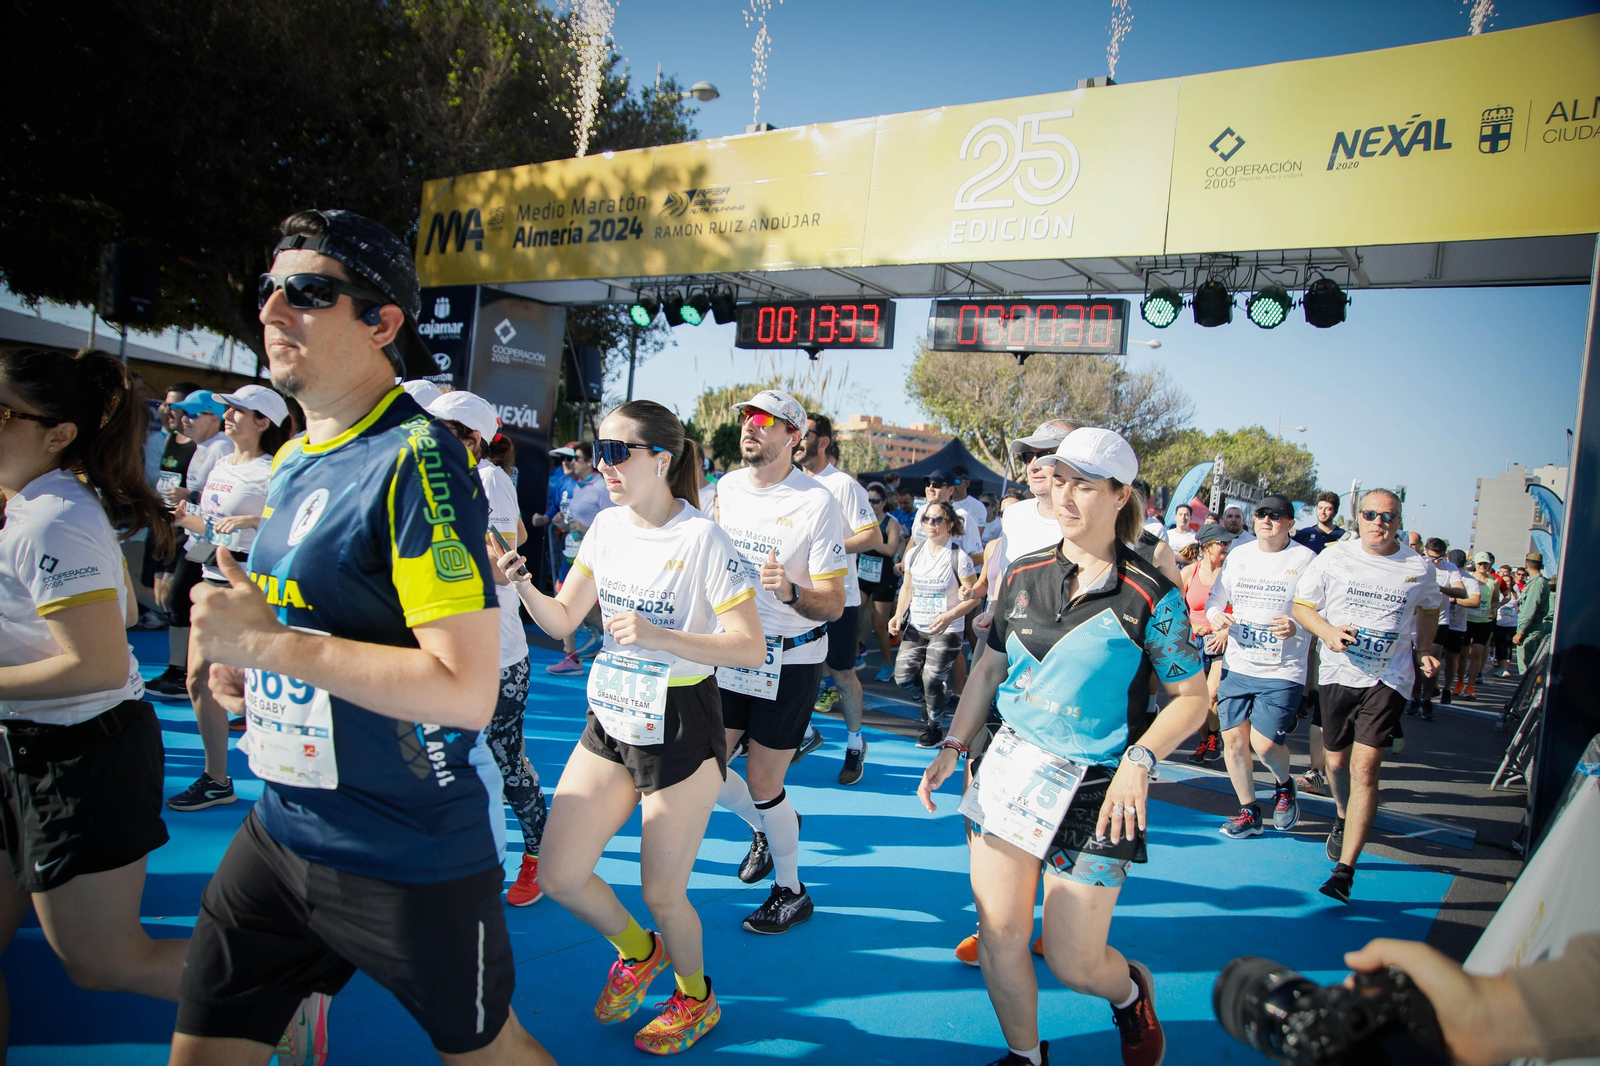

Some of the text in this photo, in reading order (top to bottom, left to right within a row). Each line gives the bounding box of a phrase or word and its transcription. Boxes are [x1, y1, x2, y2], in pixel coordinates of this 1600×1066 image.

[954, 108, 1081, 211] 25
[1336, 161, 1360, 170] 2020
[1206, 160, 1303, 178] COOPERACIÓN
[1204, 178, 1236, 190] 2005
[516, 192, 646, 221] Medio Maratón
[512, 216, 643, 248] Almería 2024
[654, 213, 821, 239] RAMÓN RUIZ ANDÚJAR
[949, 209, 1075, 244] EDICIÓN
[418, 319, 464, 339] cajamar
[757, 304, 880, 343] 00:13:33
[492, 344, 546, 362] COOPERACIÓN
[745, 530, 783, 546] Maratón
[43, 566, 99, 583] COOPERACIÓN
[46, 580, 63, 590] 2005
[600, 575, 676, 600] Medio Maratón
[1235, 582, 1264, 591] Almería
[1347, 580, 1410, 597] Medio Maratón
[599, 587, 675, 614] Almería 2024
[1346, 587, 1408, 605] Almería 2024
[1242, 627, 1278, 644] 5168
[595, 666, 659, 702] 5413
[259, 699, 287, 715] GABY
[597, 690, 629, 705] GRANALME
[630, 699, 650, 709] TEAM
